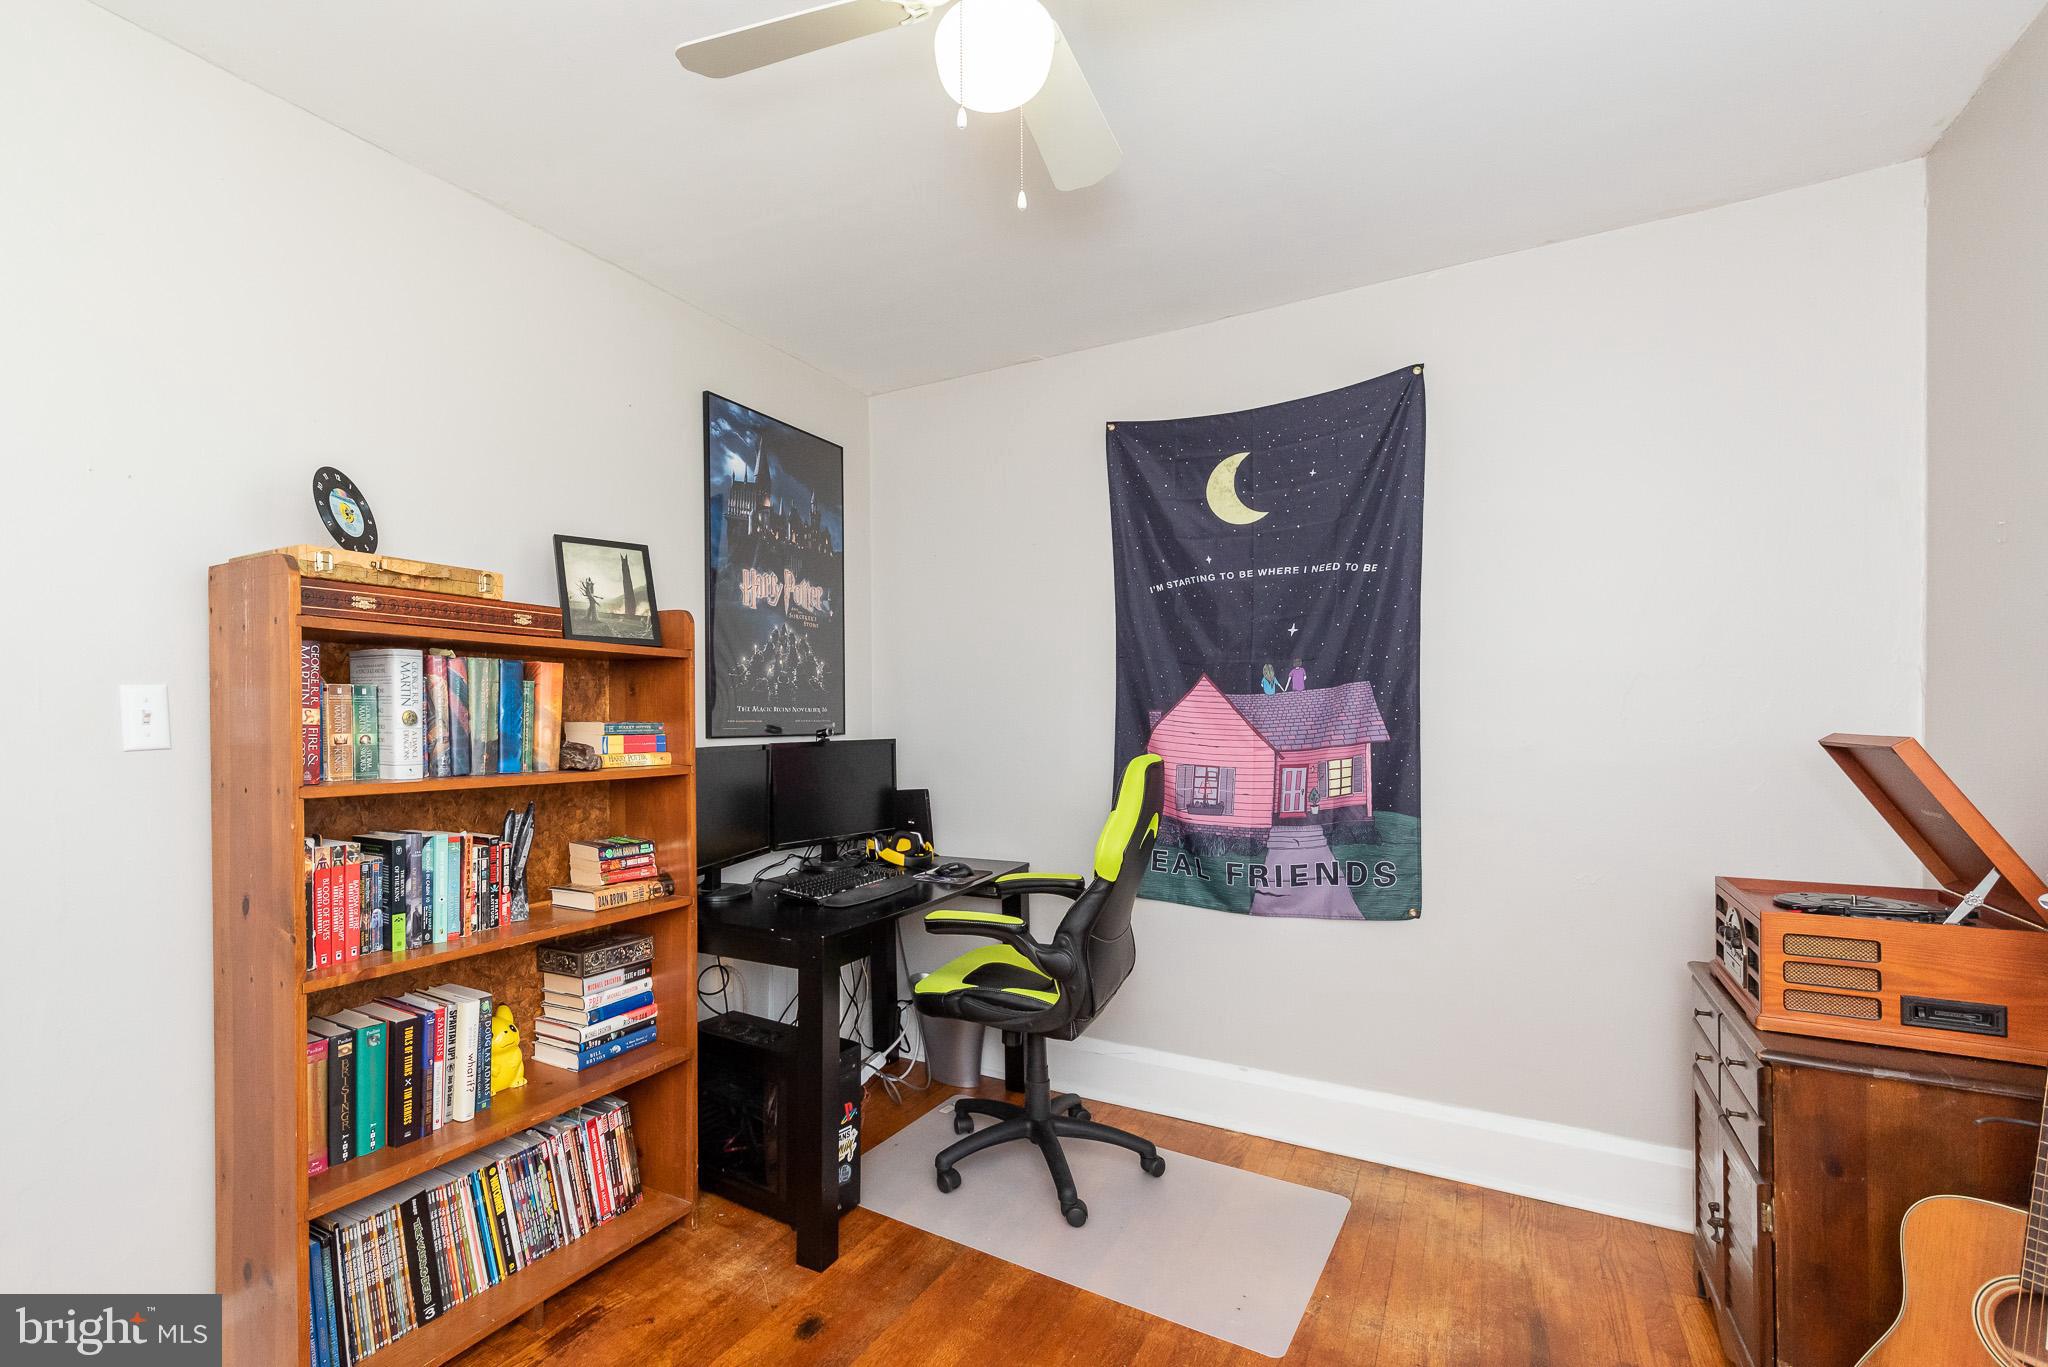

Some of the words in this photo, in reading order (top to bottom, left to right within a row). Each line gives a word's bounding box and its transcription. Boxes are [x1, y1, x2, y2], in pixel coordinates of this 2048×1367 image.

[1150, 583, 1164, 594] I'M
[1166, 572, 1216, 589] STARTING
[1220, 570, 1234, 580] TO
[1239, 568, 1254, 578] BE
[1257, 566, 1300, 577] WHERE
[1303, 565, 1308, 574] I
[1311, 562, 1341, 573] NEED
[1345, 562, 1359, 572] TO
[1363, 563, 1378, 573] BE
[740, 568, 783, 609] Harry
[784, 568, 824, 615] Potter
[310, 644, 320, 684] GEORGE
[400, 660, 411, 707] MARTIN
[308, 728, 318, 750] FIRE
[307, 752, 318, 767] &
[1150, 848, 1210, 881] EAL
[1226, 860, 1398, 888] FRIENDS
[466, 888, 471, 900] Z
[598, 895, 609, 908] DAN
[610, 890, 628, 906] BROWN
[322, 908, 330, 917] OF
[322, 920, 330, 940] ELVES
[404, 1026, 414, 1046] TOOLS
[448, 1010, 457, 1044] SPARTAN
[448, 1046, 456, 1060] UP!
[404, 1054, 412, 1076] TITANS
[467, 1053, 476, 1078] what
[404, 1087, 412, 1100] TIM
[466, 1080, 475, 1092] if?
[490, 1174, 506, 1216] WATCHMEN
[600, 1192, 608, 1212] ARCHIVE
[416, 1237, 427, 1276] WALKING
[420, 1276, 432, 1304] DEAD
